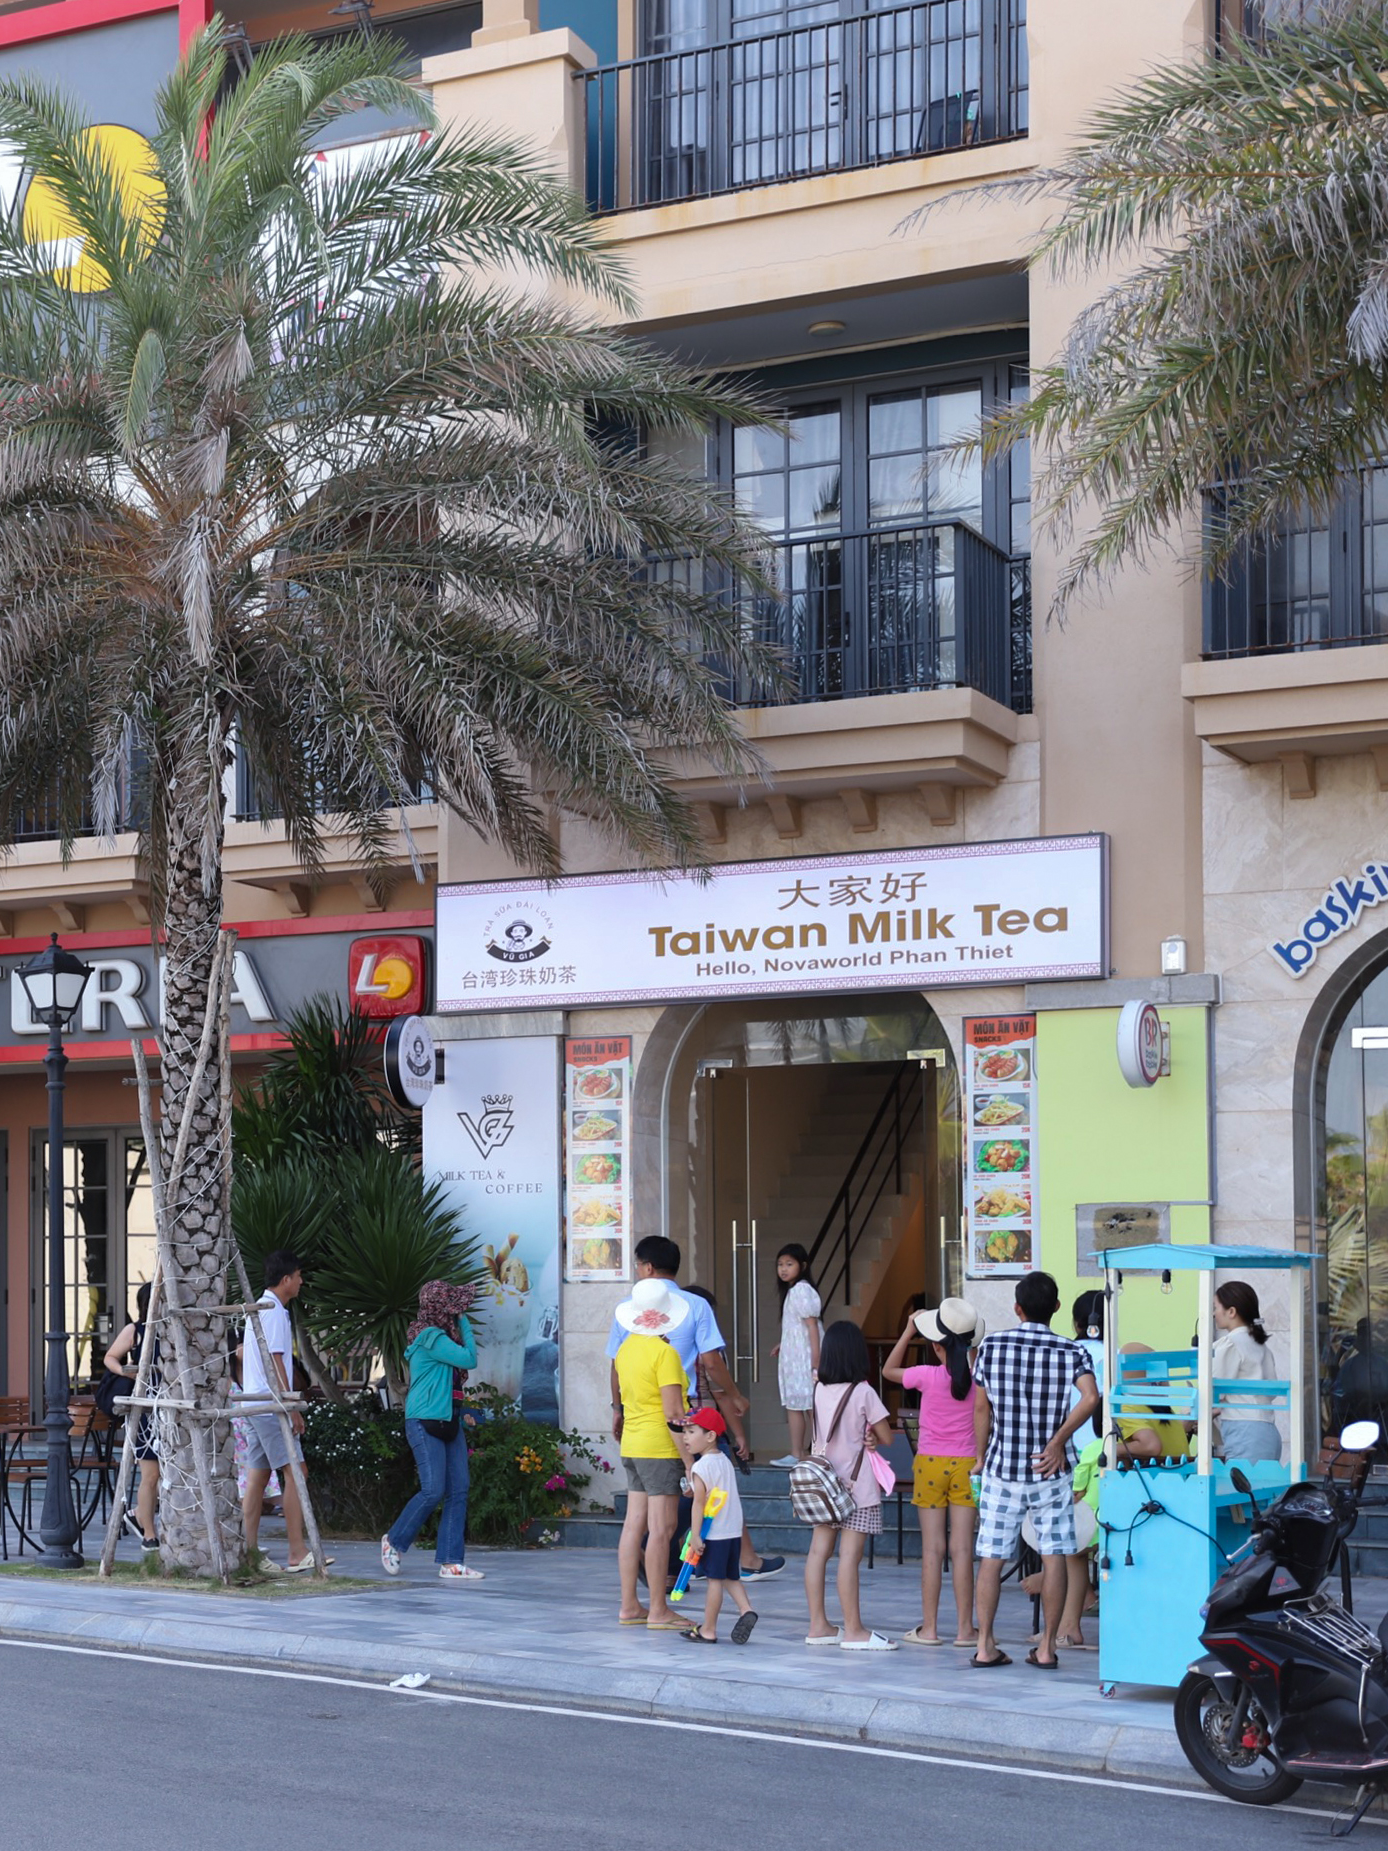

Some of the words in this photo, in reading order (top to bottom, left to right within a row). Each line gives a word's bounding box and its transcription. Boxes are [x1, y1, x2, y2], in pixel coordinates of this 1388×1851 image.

[778, 872, 927, 910] 大家好
[648, 923, 827, 957] Taiwan
[849, 908, 955, 944] Milk
[973, 904, 1068, 936] Tea
[1273, 865, 1388, 973] baski
[518, 951, 535, 960] GIA
[696, 961, 756, 976] Hello,
[764, 951, 881, 972] Novaworld
[890, 950, 947, 964] Phan
[955, 944, 1013, 960] Thiet
[462, 965, 577, 989] 台湾珍珠奶茶
[439, 1171, 465, 1181] MILK
[470, 1170, 492, 1180] TEA
[497, 1169, 505, 1179] &
[485, 1183, 543, 1194] COFFEE
